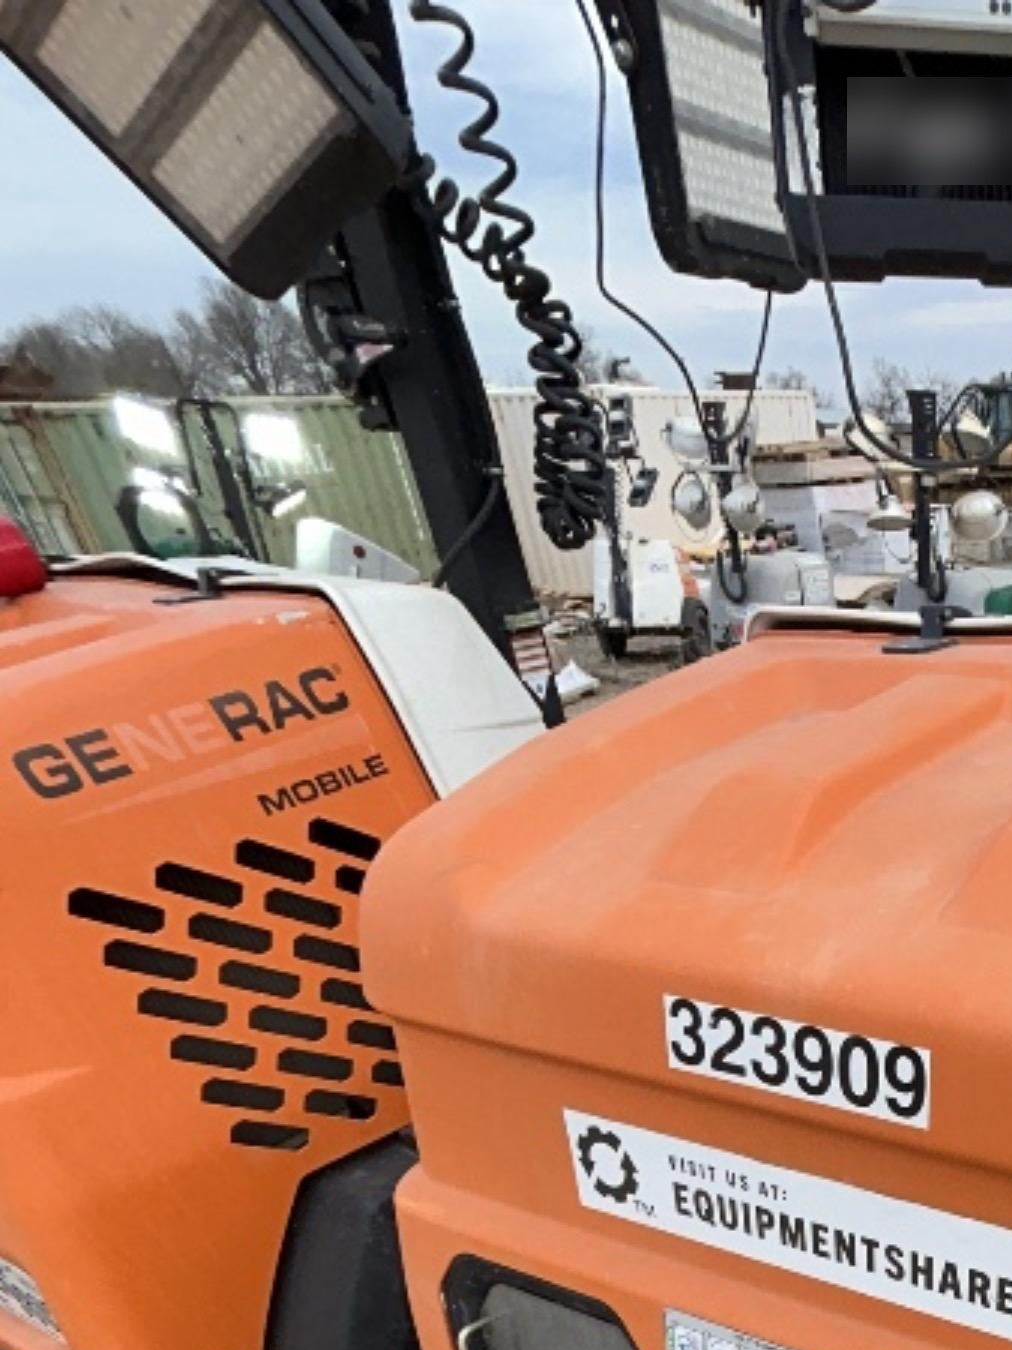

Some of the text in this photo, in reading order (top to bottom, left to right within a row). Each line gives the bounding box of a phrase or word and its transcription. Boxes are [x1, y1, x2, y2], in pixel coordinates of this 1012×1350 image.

[12, 667, 349, 799] GENERAC
[256, 754, 392, 816] MOBILE
[669, 998, 926, 1118] 323909
[668, 1155, 787, 1201] VISIT US AT:
